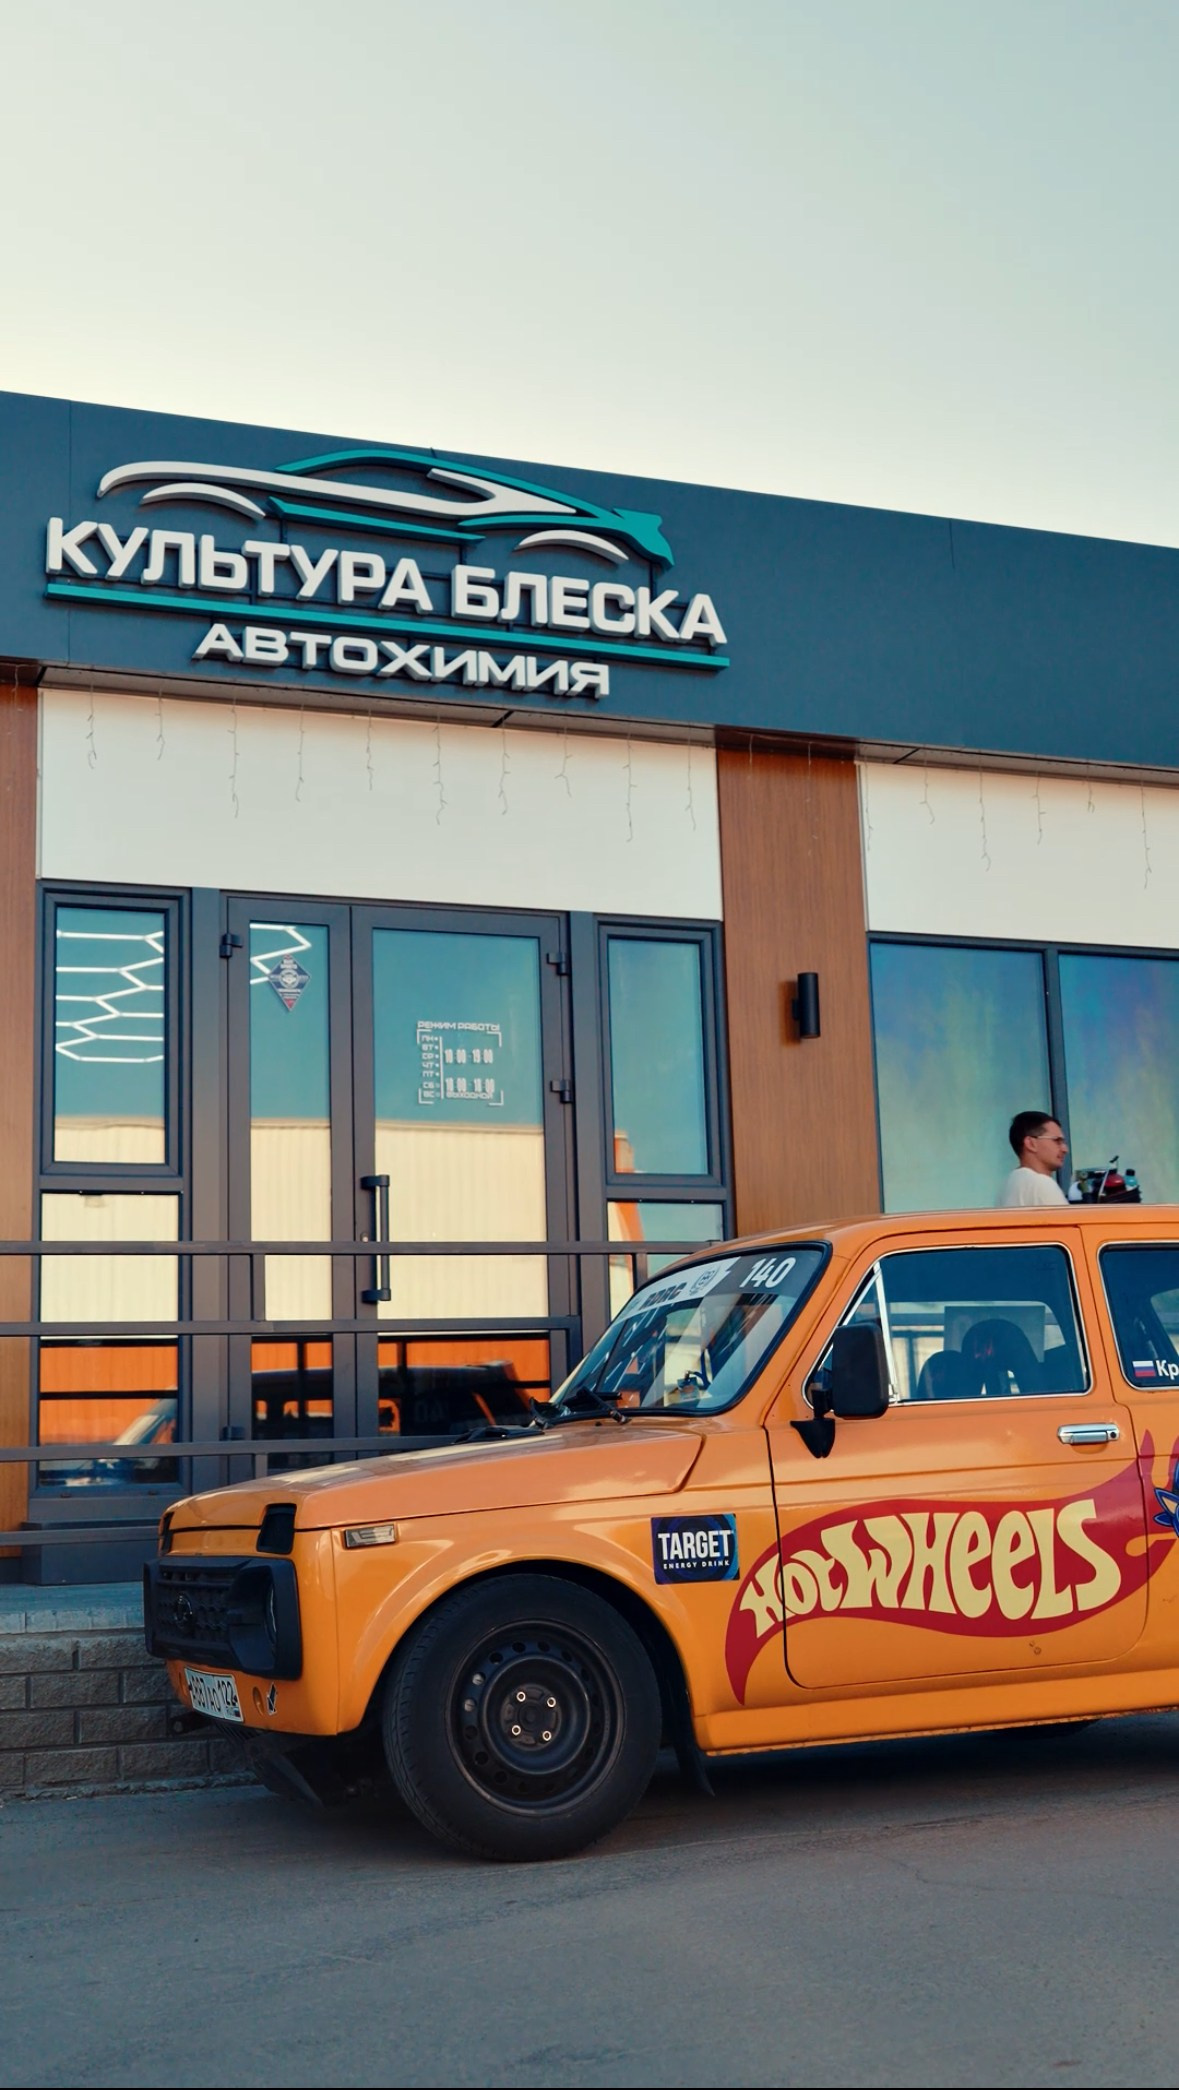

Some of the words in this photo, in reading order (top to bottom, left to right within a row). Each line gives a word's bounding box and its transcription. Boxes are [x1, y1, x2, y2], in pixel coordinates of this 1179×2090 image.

[46, 517, 433, 614] КУЛЬТУРА
[452, 564, 728, 648] БЛЕСКА
[193, 622, 610, 698] АВТОХИМИЯ
[417, 1021, 456, 1030] РЕЖИМ
[457, 1022, 500, 1031] РАБОТЫ
[421, 1034, 434, 1042] ПН
[423, 1081, 434, 1089] СБ
[423, 1090, 435, 1098] ВС
[739, 1257, 796, 1288] 140
[657, 1530, 732, 1560] TARGET
[663, 1562, 698, 1570] ENERGY
